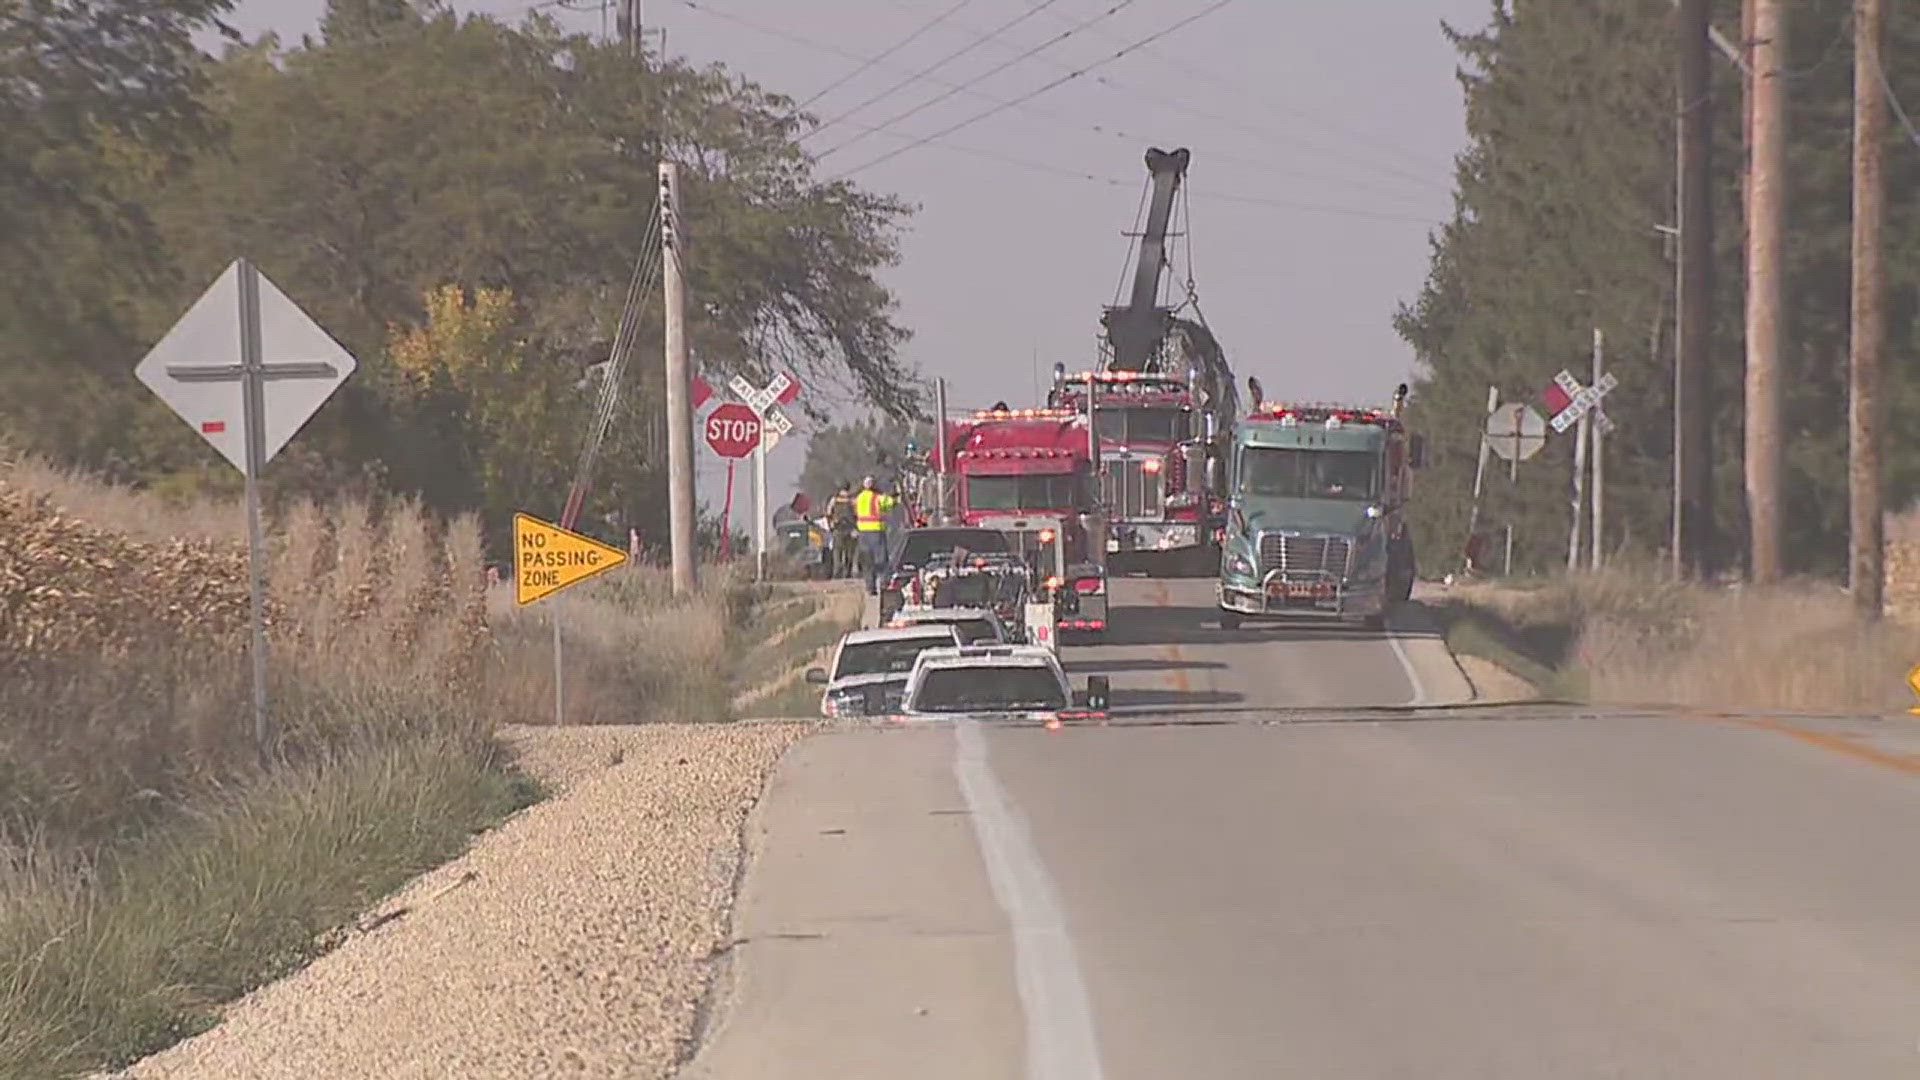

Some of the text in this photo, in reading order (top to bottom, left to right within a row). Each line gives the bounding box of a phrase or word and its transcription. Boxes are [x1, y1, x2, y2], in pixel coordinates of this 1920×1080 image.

[708, 419, 758, 442] STOP
[522, 532, 546, 548] NO
[523, 550, 598, 567] PASSING
[523, 570, 560, 587] ZONE
